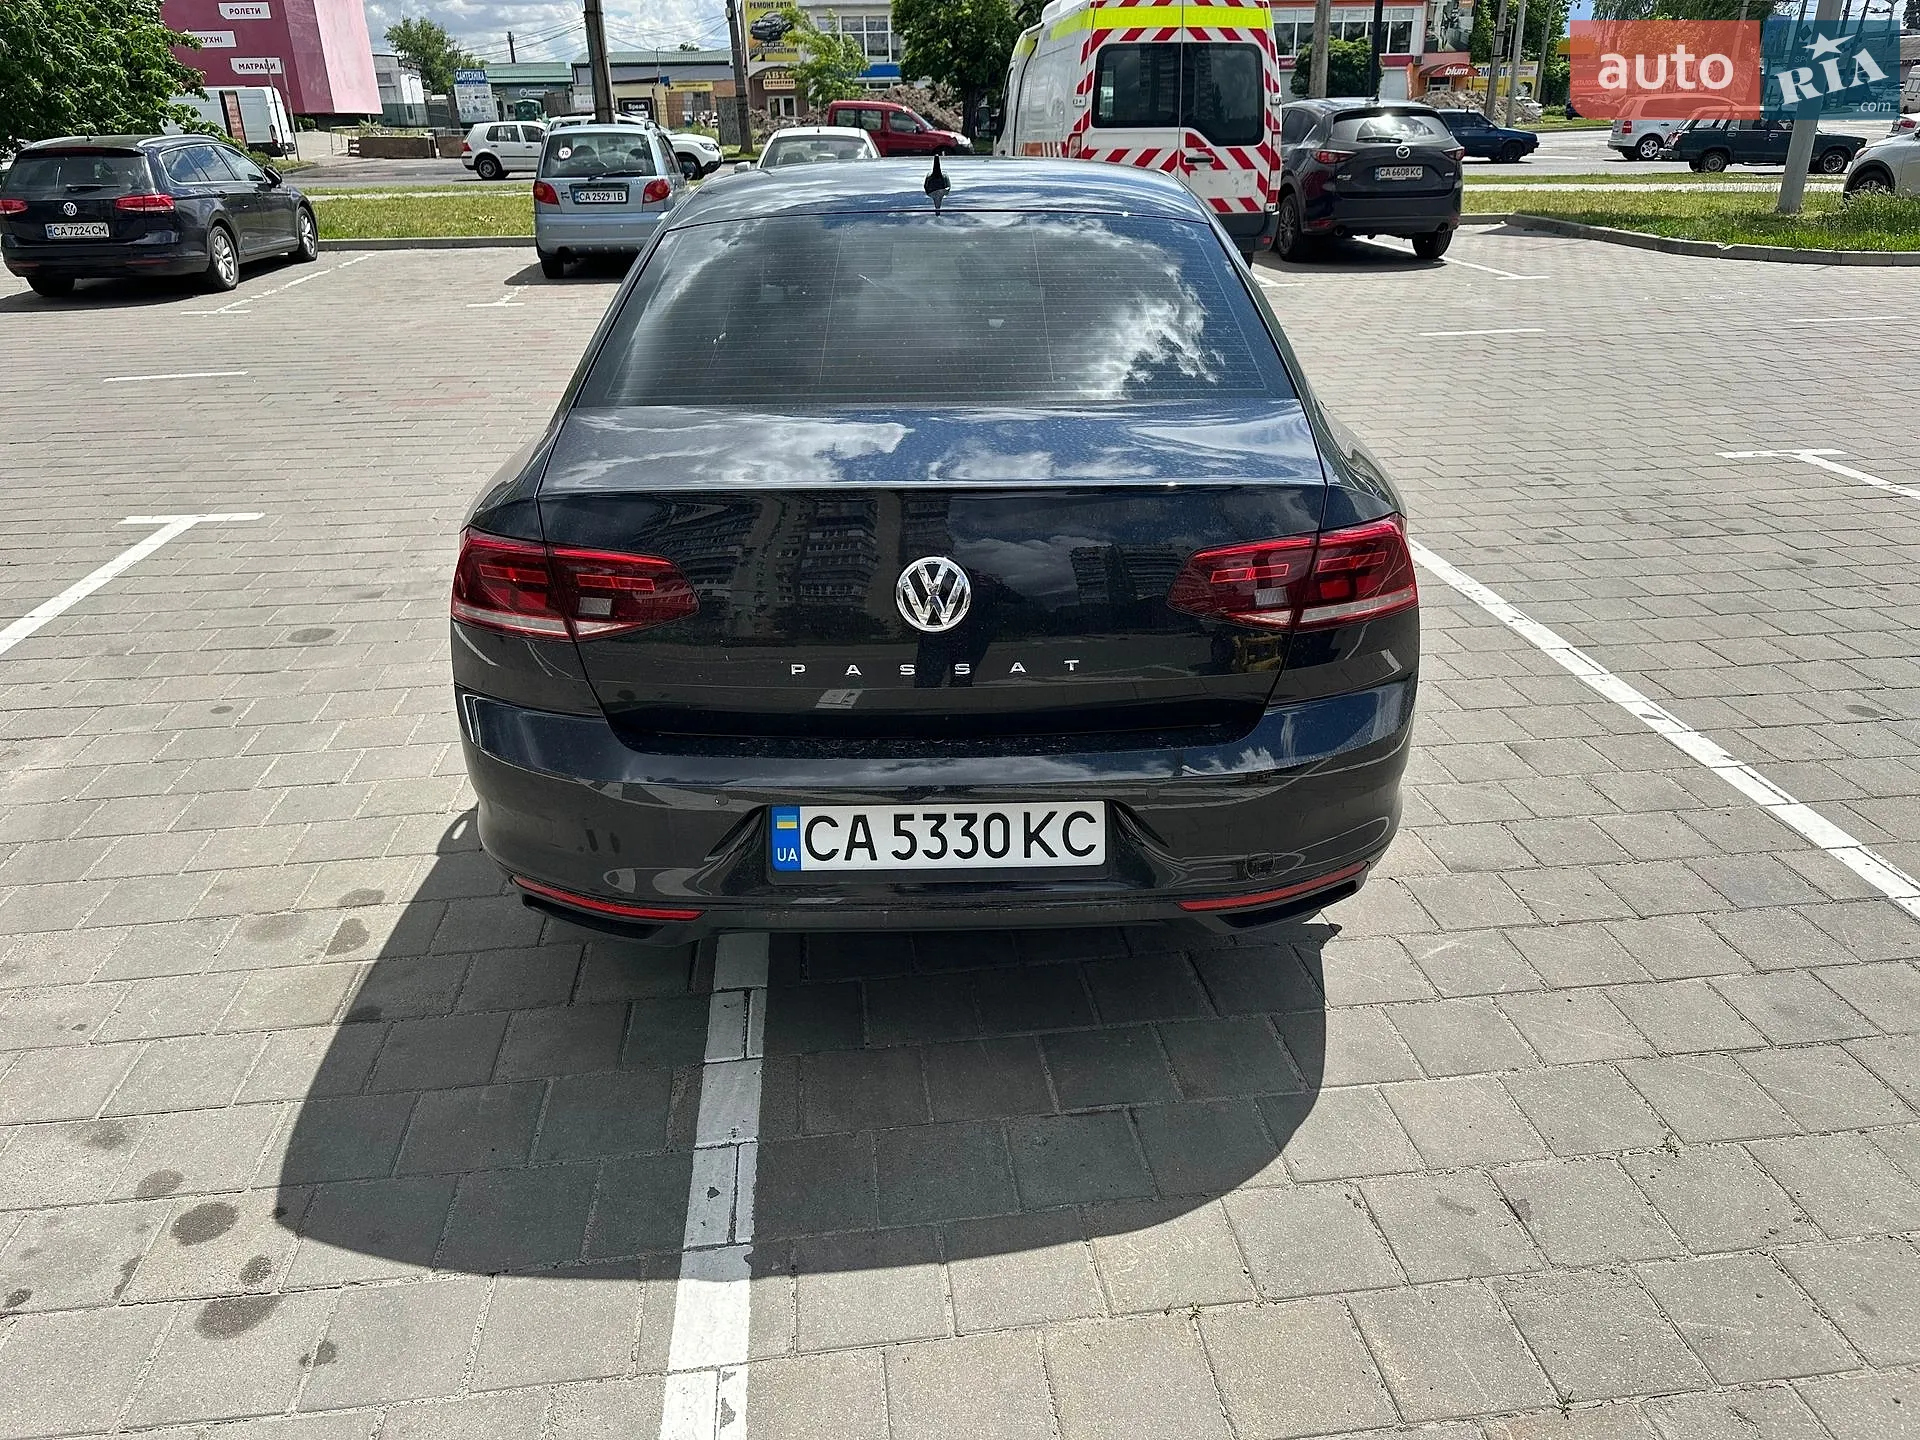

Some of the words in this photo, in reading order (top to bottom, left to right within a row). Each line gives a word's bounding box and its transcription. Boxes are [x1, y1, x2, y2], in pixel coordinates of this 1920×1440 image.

[749, 1, 774, 9] РЕМОНТ
[775, 1, 792, 9] АВТО
[229, 7, 261, 15] РОЛЕТИ
[198, 36, 223, 44] КУХНІ
[238, 63, 276, 71] МАТРАЦИ
[1445, 66, 1469, 76] blum
[455, 70, 486, 81] САНТЕХНІКА
[628, 103, 645, 111] Speak
[1380, 168, 1391, 177] CA
[1392, 168, 1410, 177] 6608
[1410, 167, 1422, 176] KC
[579, 192, 591, 201] CA
[592, 192, 610, 201] 2529
[613, 192, 624, 201] IB
[54, 226, 67, 236] CA
[68, 226, 91, 236] 7224
[91, 225, 107, 235] CM
[790, 659, 1080, 676] PASSAT
[804, 814, 878, 862] CA
[891, 811, 1011, 861] 5330
[1023, 810, 1097, 859] KC
[777, 847, 798, 862] UA
